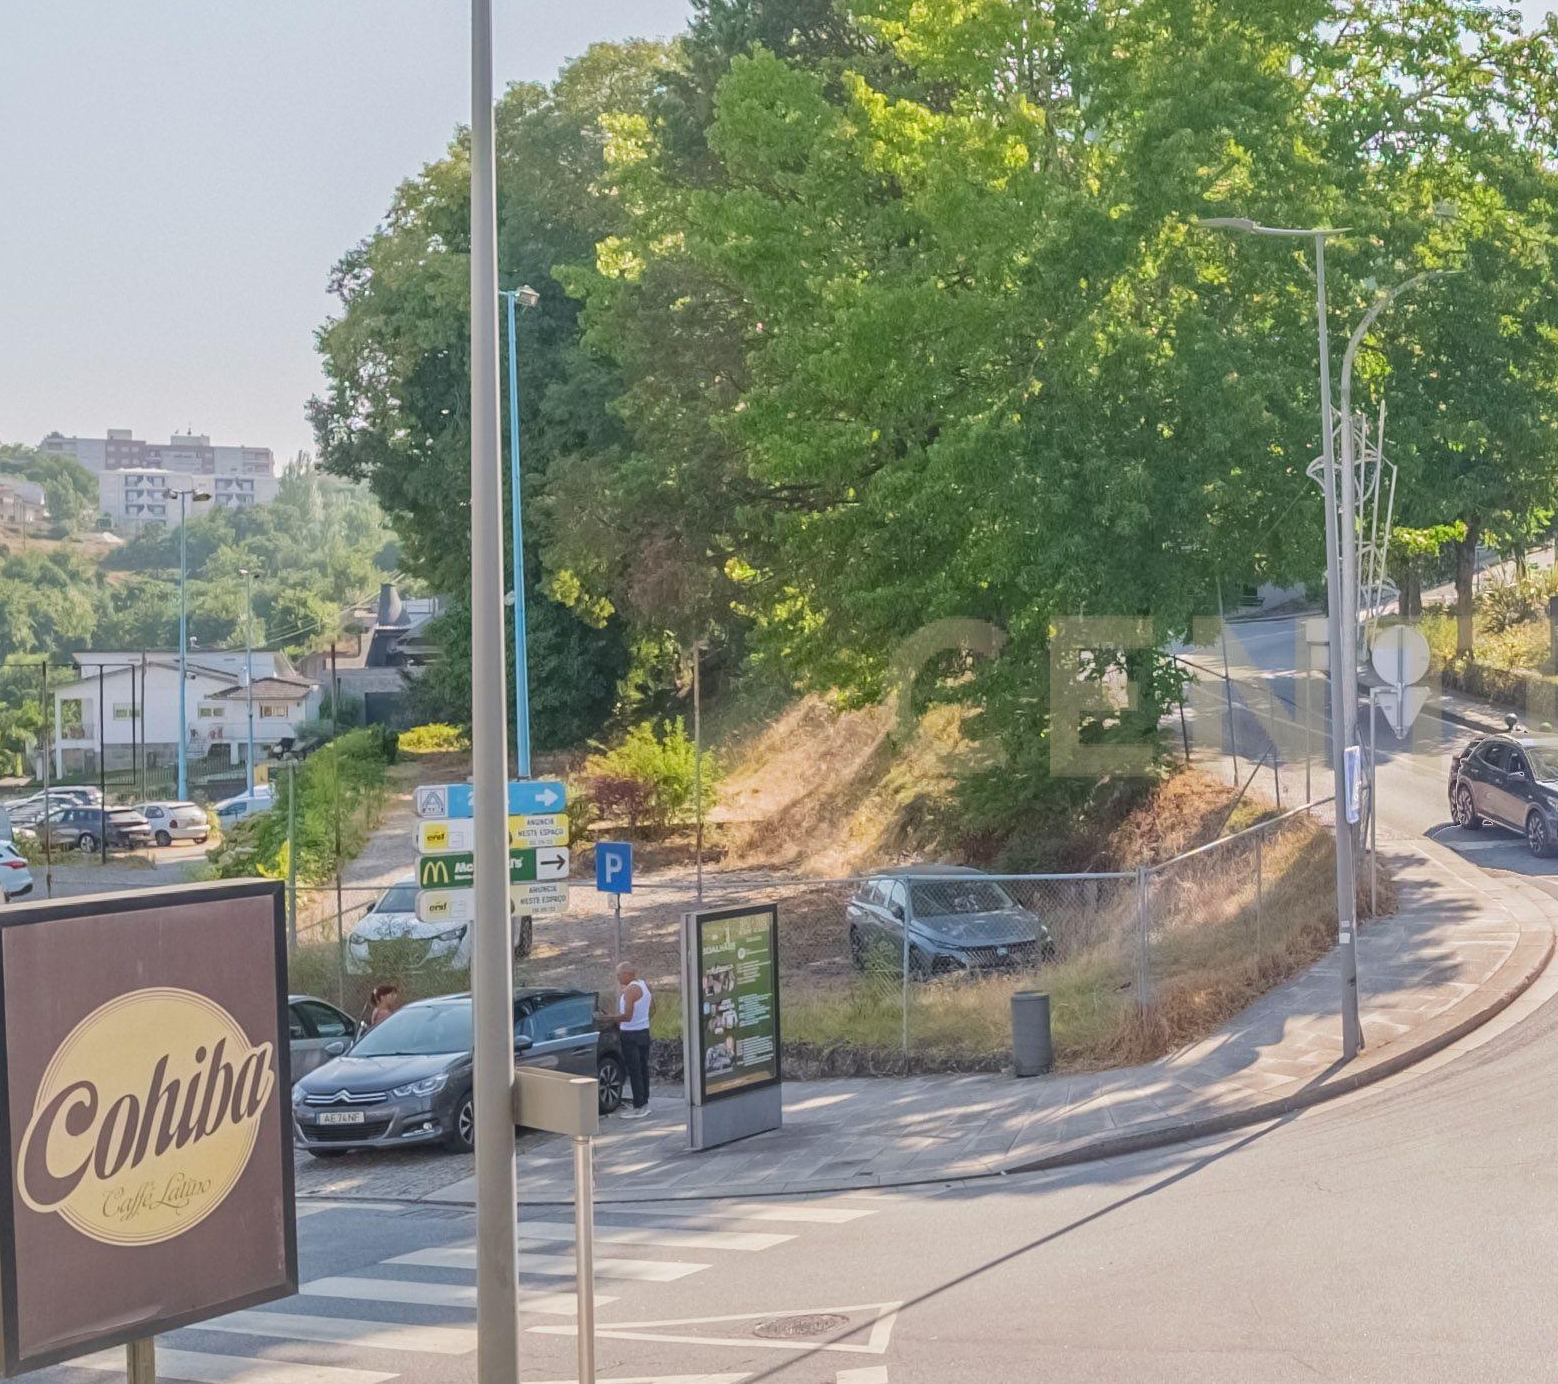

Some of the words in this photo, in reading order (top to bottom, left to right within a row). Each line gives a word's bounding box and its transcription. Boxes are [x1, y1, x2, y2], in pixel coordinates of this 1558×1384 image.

[605, 853, 622, 883] P
[23, 1035, 271, 1207] Cohiba
[155, 1172, 211, 1216] Latino
